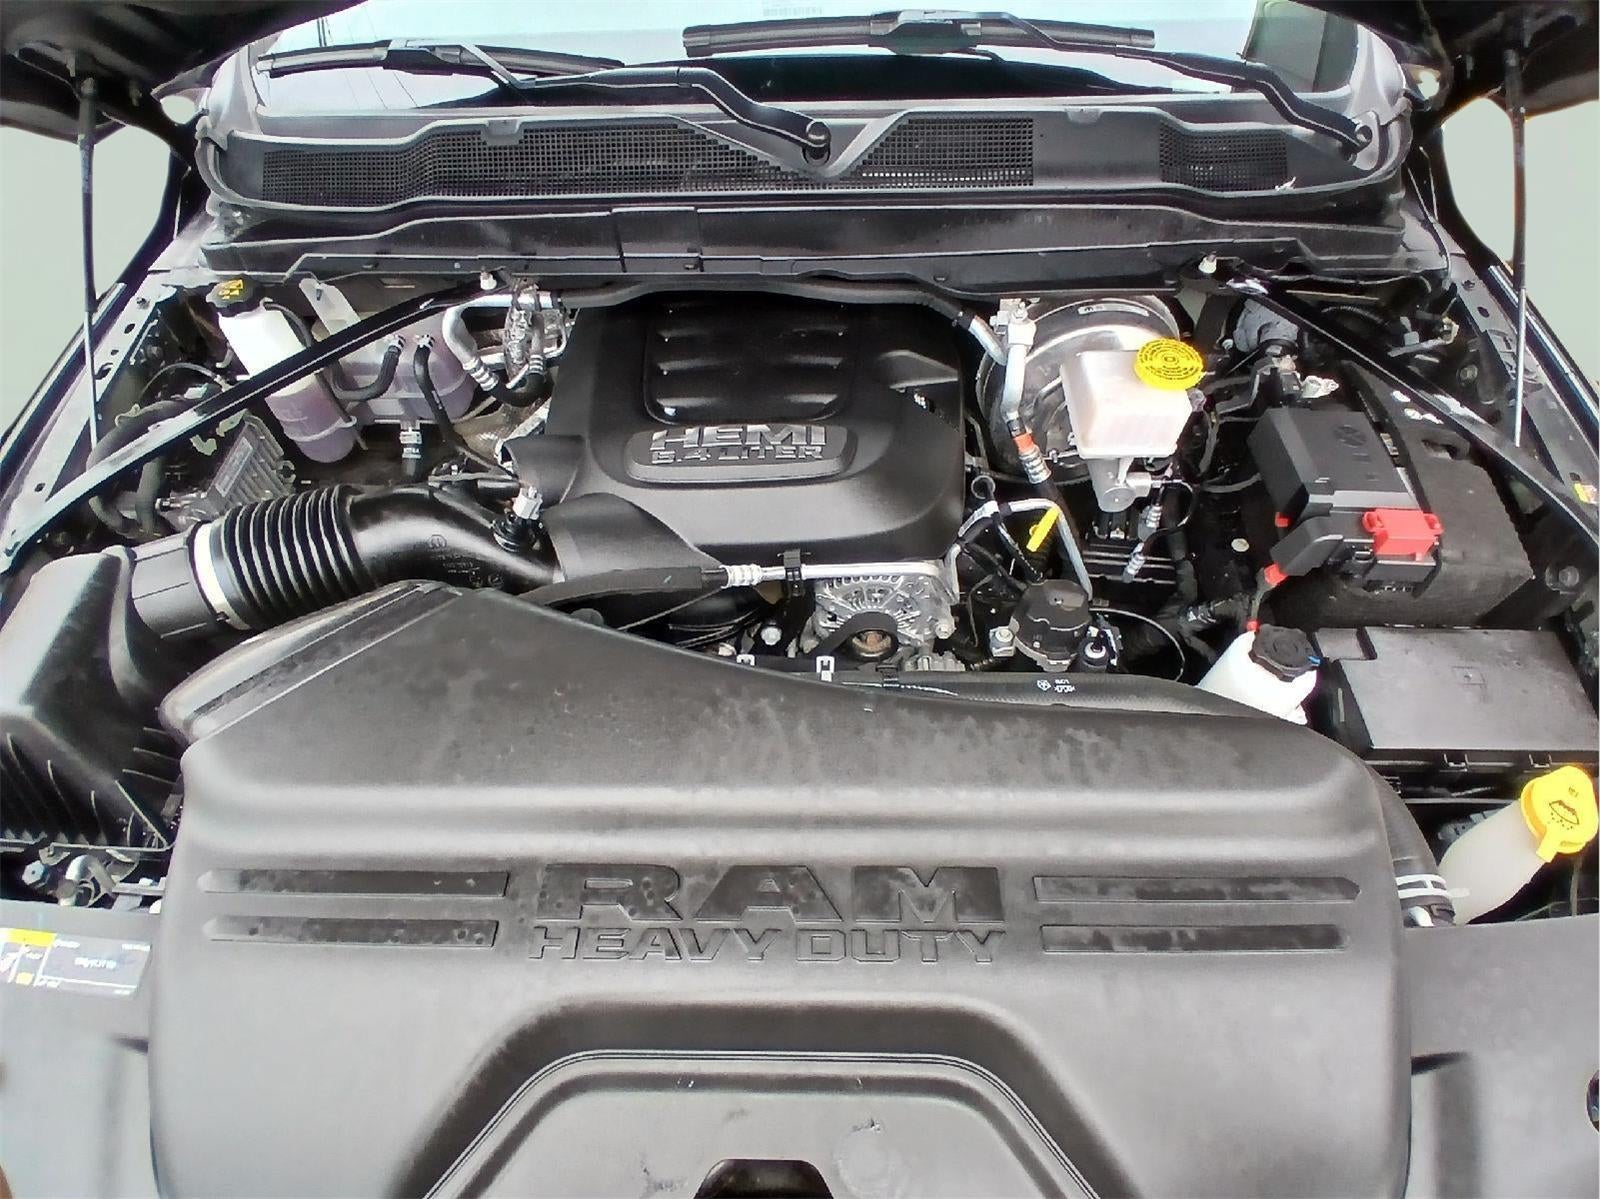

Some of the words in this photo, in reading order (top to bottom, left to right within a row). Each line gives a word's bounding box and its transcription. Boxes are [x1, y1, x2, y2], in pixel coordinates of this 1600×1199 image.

[650, 424, 826, 450] HEMI
[718, 446, 825, 461] LITER
[536, 864, 1005, 923] RAM
[529, 926, 782, 962] HEAVY
[796, 929, 1006, 963] DUTY
